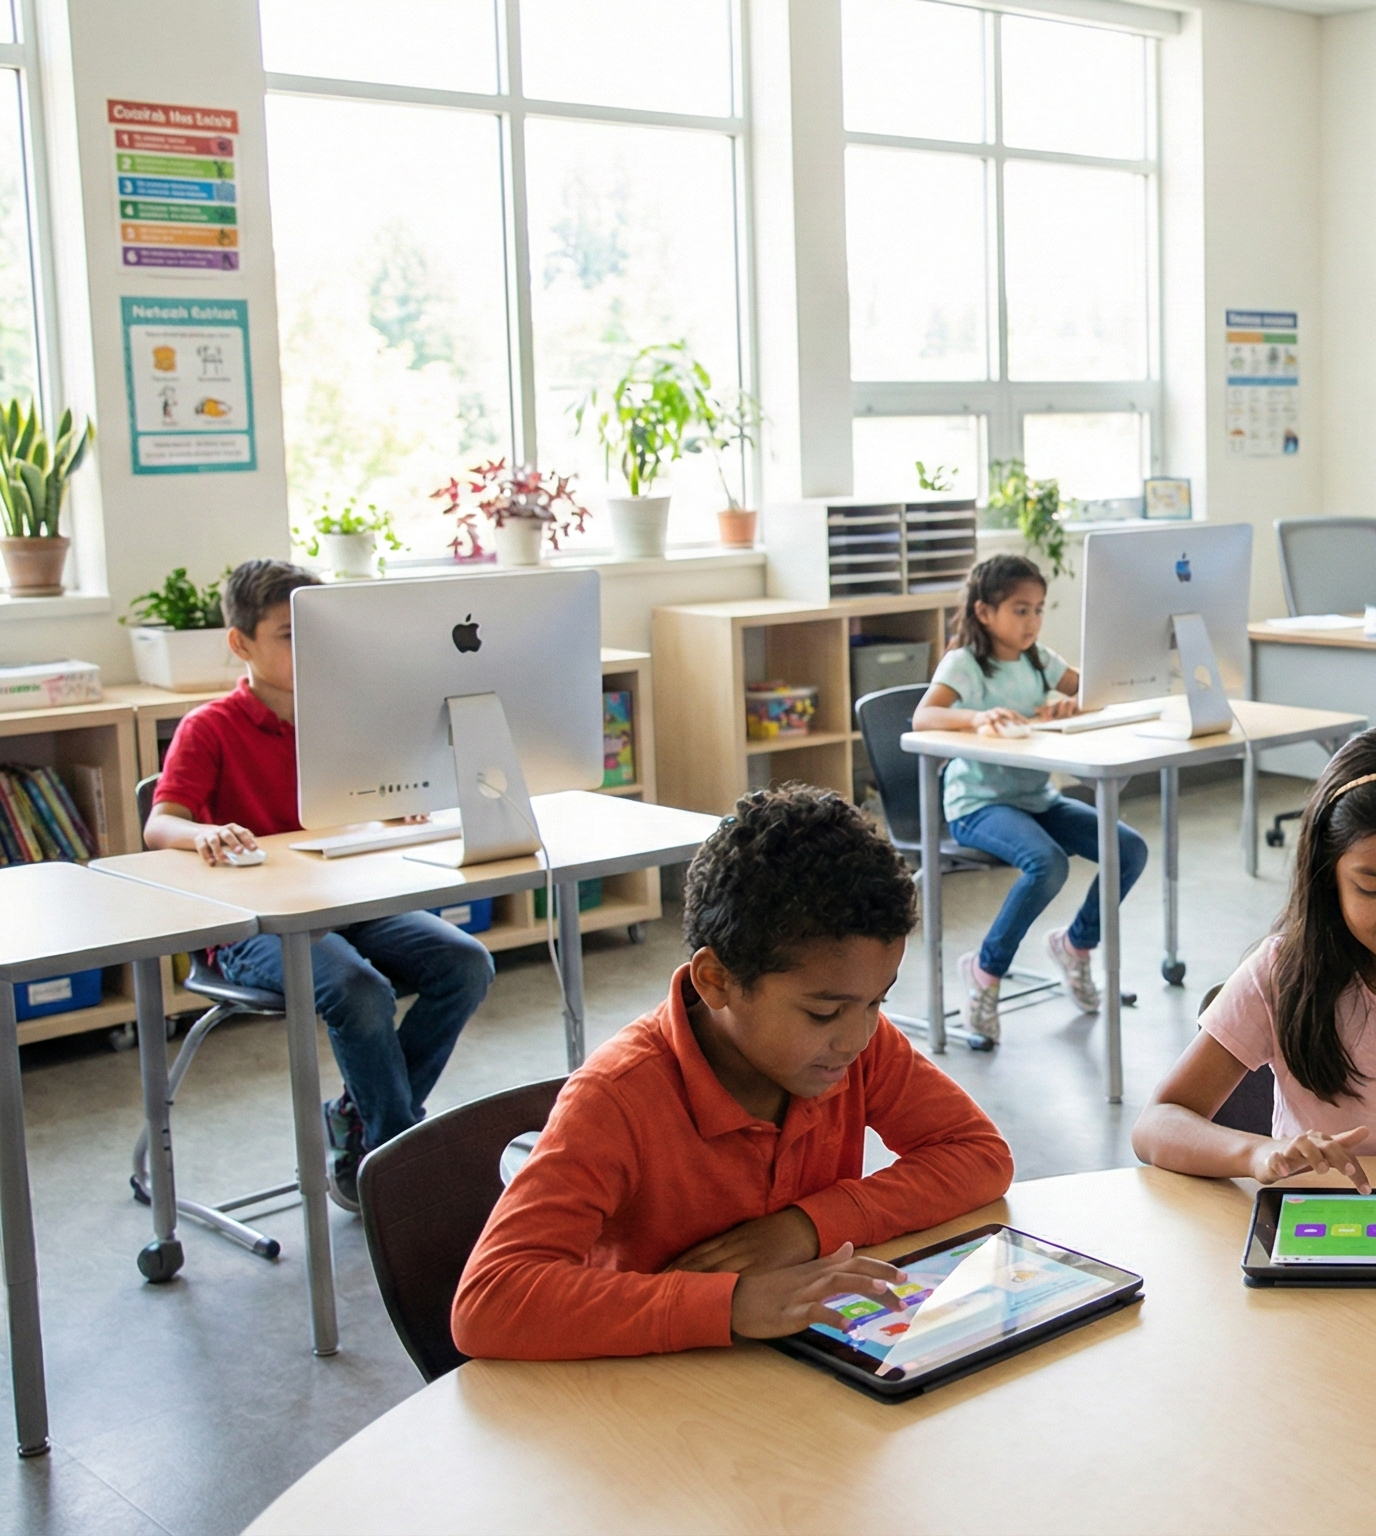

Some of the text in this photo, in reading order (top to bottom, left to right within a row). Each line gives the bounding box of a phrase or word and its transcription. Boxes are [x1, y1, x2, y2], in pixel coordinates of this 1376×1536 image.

[121, 133, 129, 146] 1
[122, 157, 132, 170] 2
[123, 180, 134, 193] 3
[124, 203, 134, 216] 4
[126, 250, 138, 263] 6
